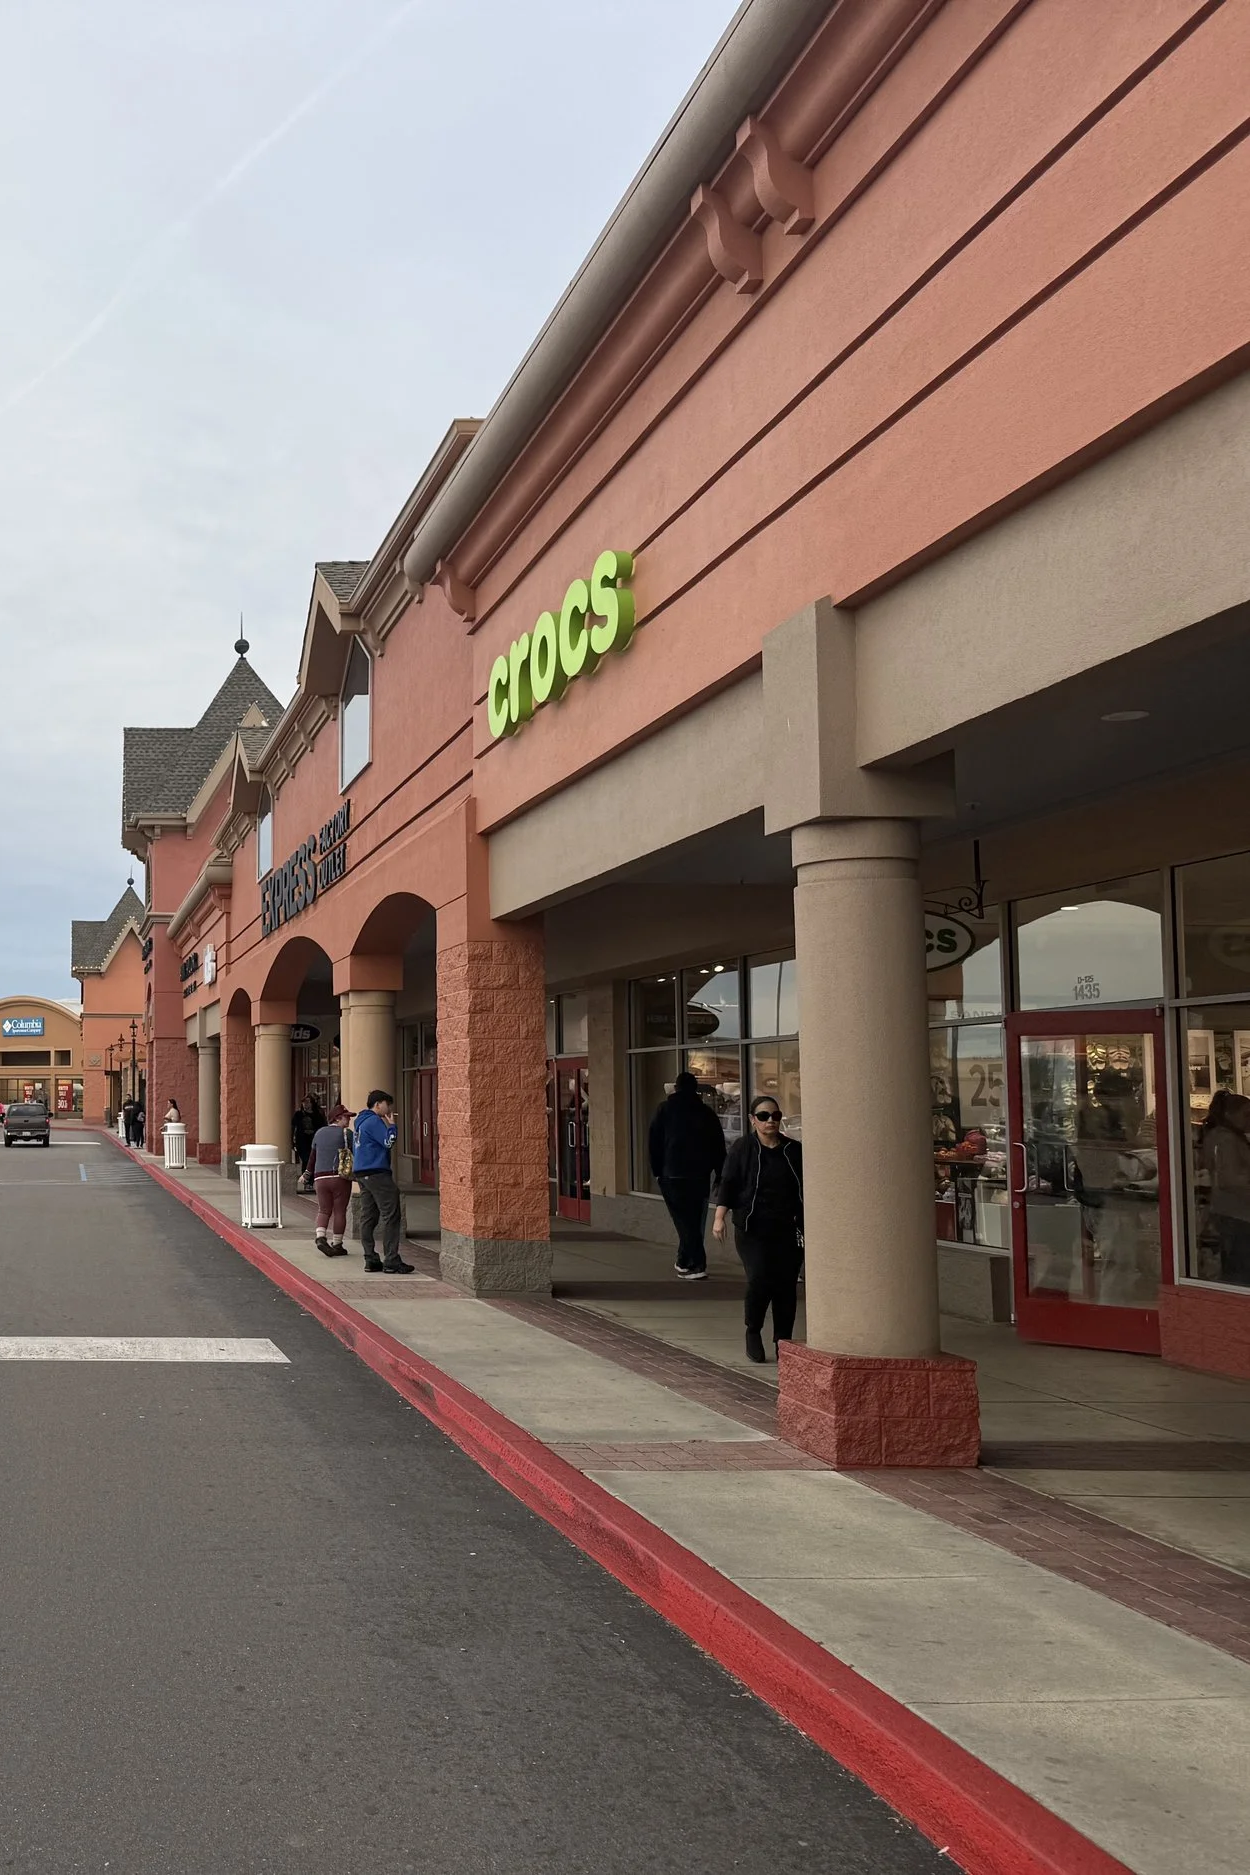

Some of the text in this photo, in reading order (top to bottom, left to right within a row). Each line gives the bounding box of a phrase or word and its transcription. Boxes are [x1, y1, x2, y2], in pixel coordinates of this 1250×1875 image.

[488, 550, 631, 738] crocs
[319, 799, 351, 855] FACTORY
[261, 834, 317, 938] EXPRESS
[318, 843, 347, 889] OUTLET
[1072, 983, 1101, 1000] 1435
[11, 1019, 42, 1028] Columbia
